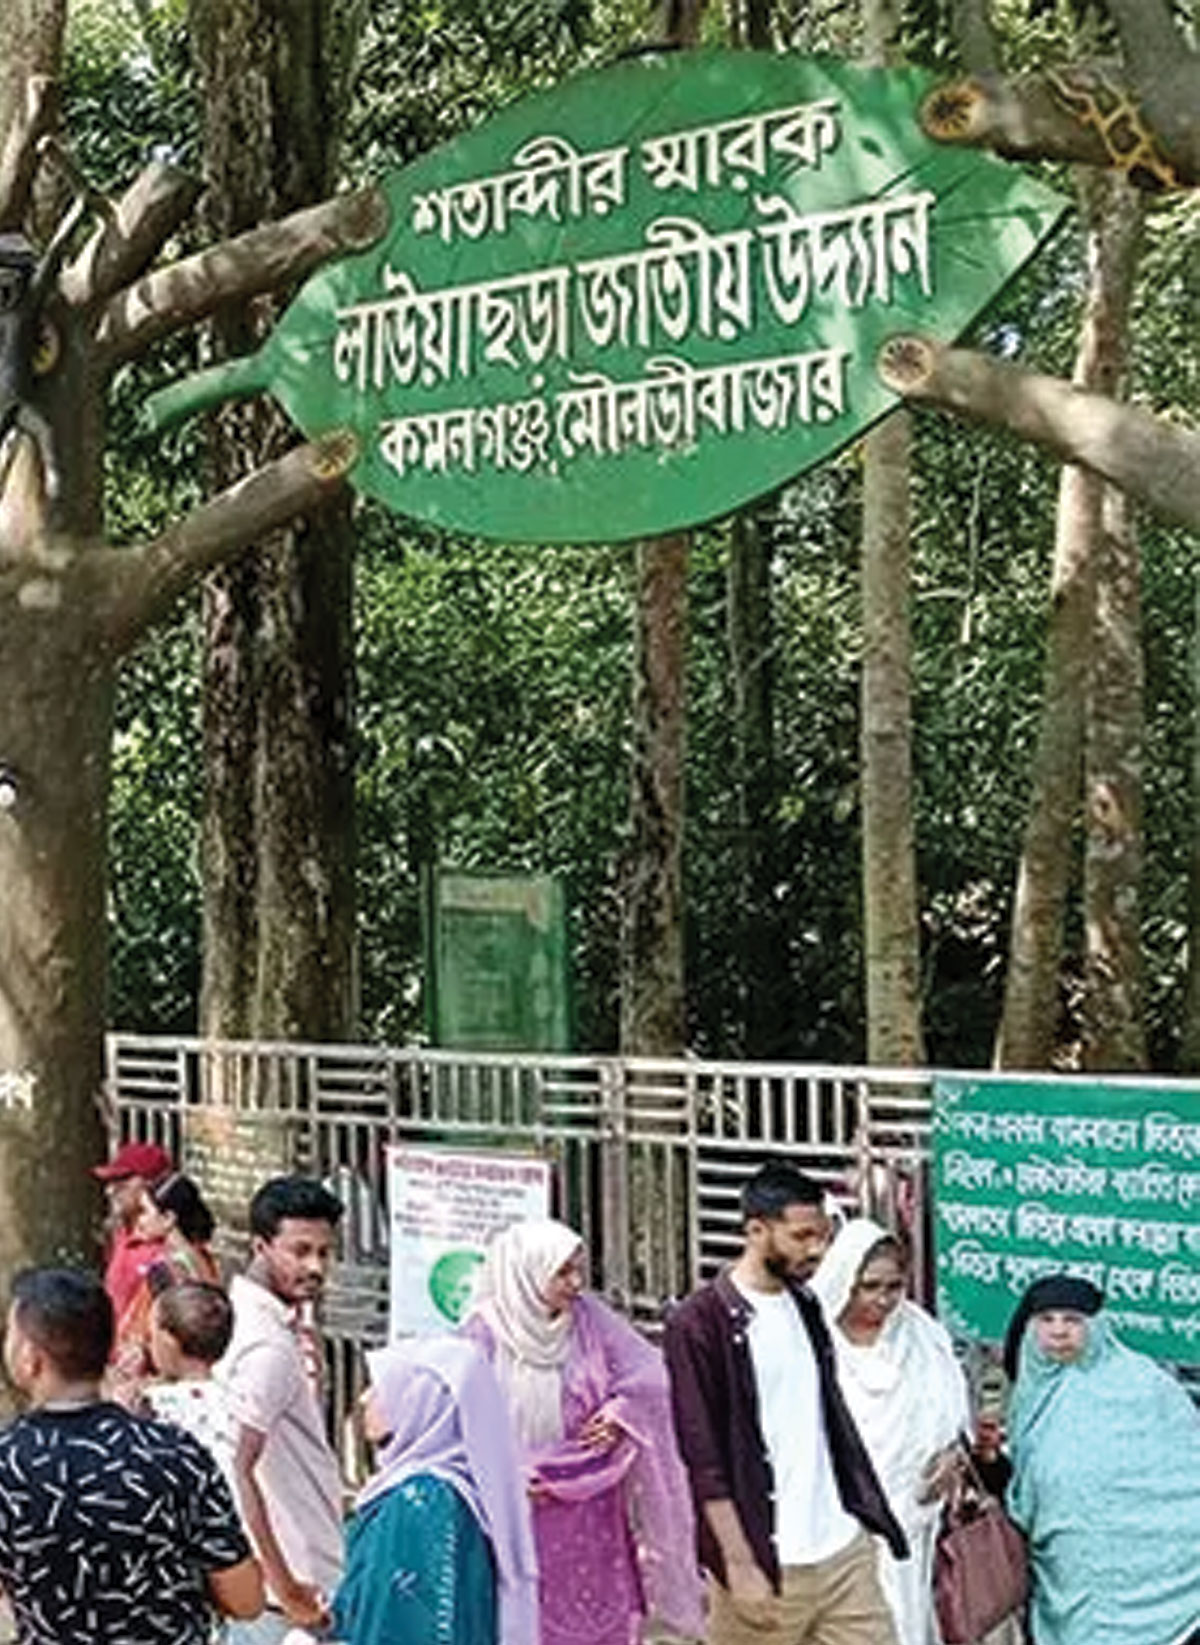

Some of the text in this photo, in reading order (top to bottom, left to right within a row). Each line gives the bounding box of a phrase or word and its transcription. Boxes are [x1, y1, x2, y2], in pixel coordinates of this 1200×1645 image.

[412, 97, 840, 243] শতাব্দীর স্মারক
[332, 190, 937, 391] লাউয়াছড়া জাতীয় উদ্যান
